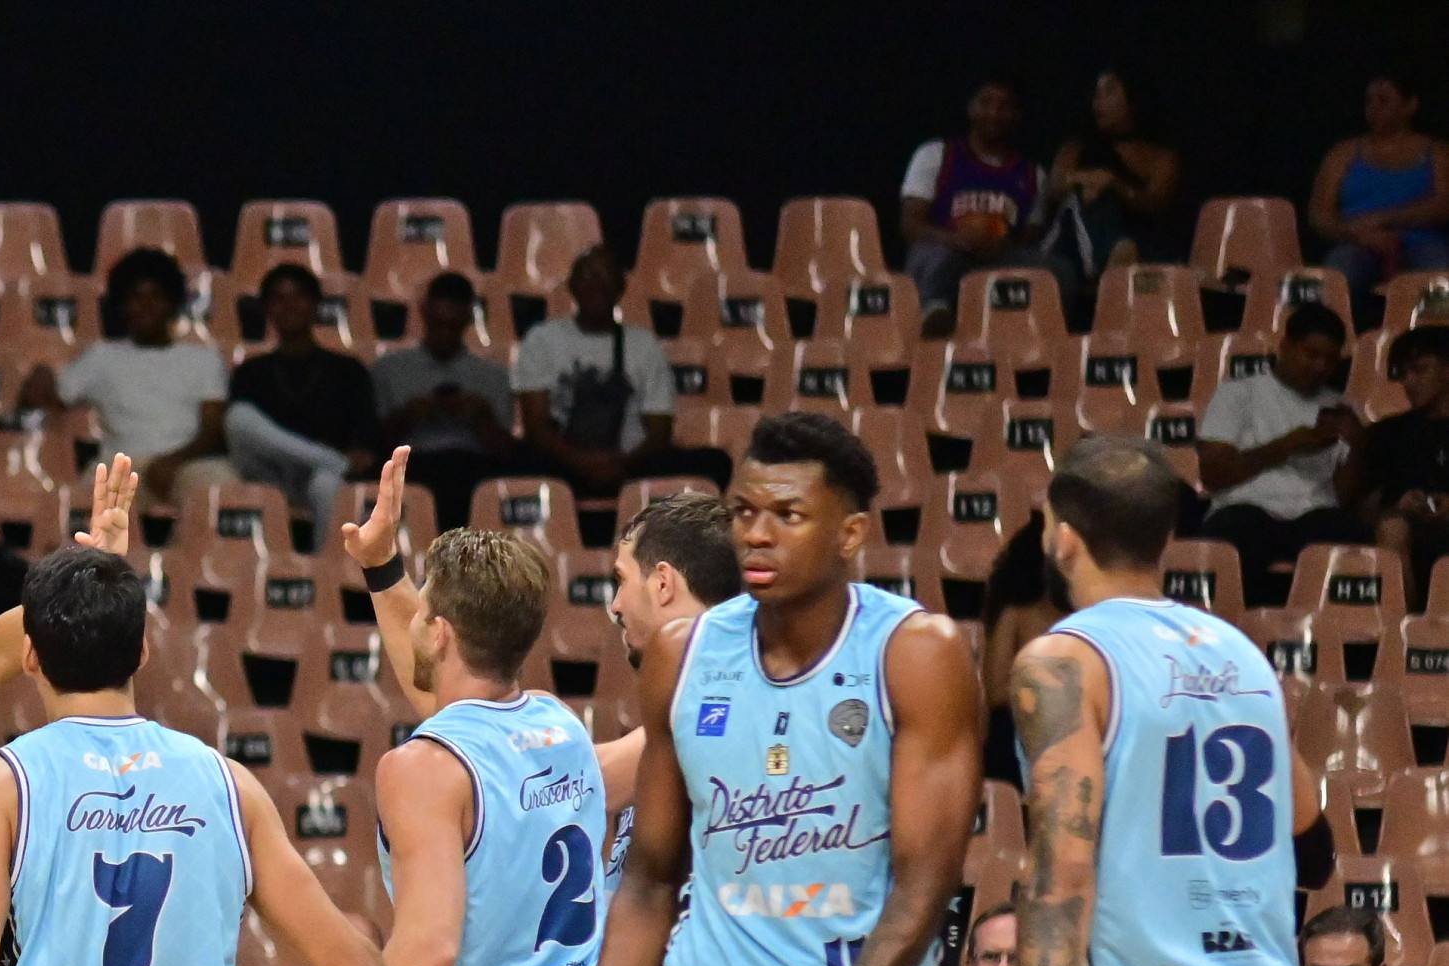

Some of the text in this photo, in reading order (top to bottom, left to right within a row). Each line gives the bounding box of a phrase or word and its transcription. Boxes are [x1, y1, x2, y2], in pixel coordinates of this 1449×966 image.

[1337, 580, 1351, 600] H
[66, 784, 206, 838] Corvalan
[702, 774, 846, 848] Distrito
[1160, 722, 1277, 861] 13
[735, 803, 891, 875] Federal
[533, 824, 597, 953] 2
[718, 881, 856, 918] CAIXA
